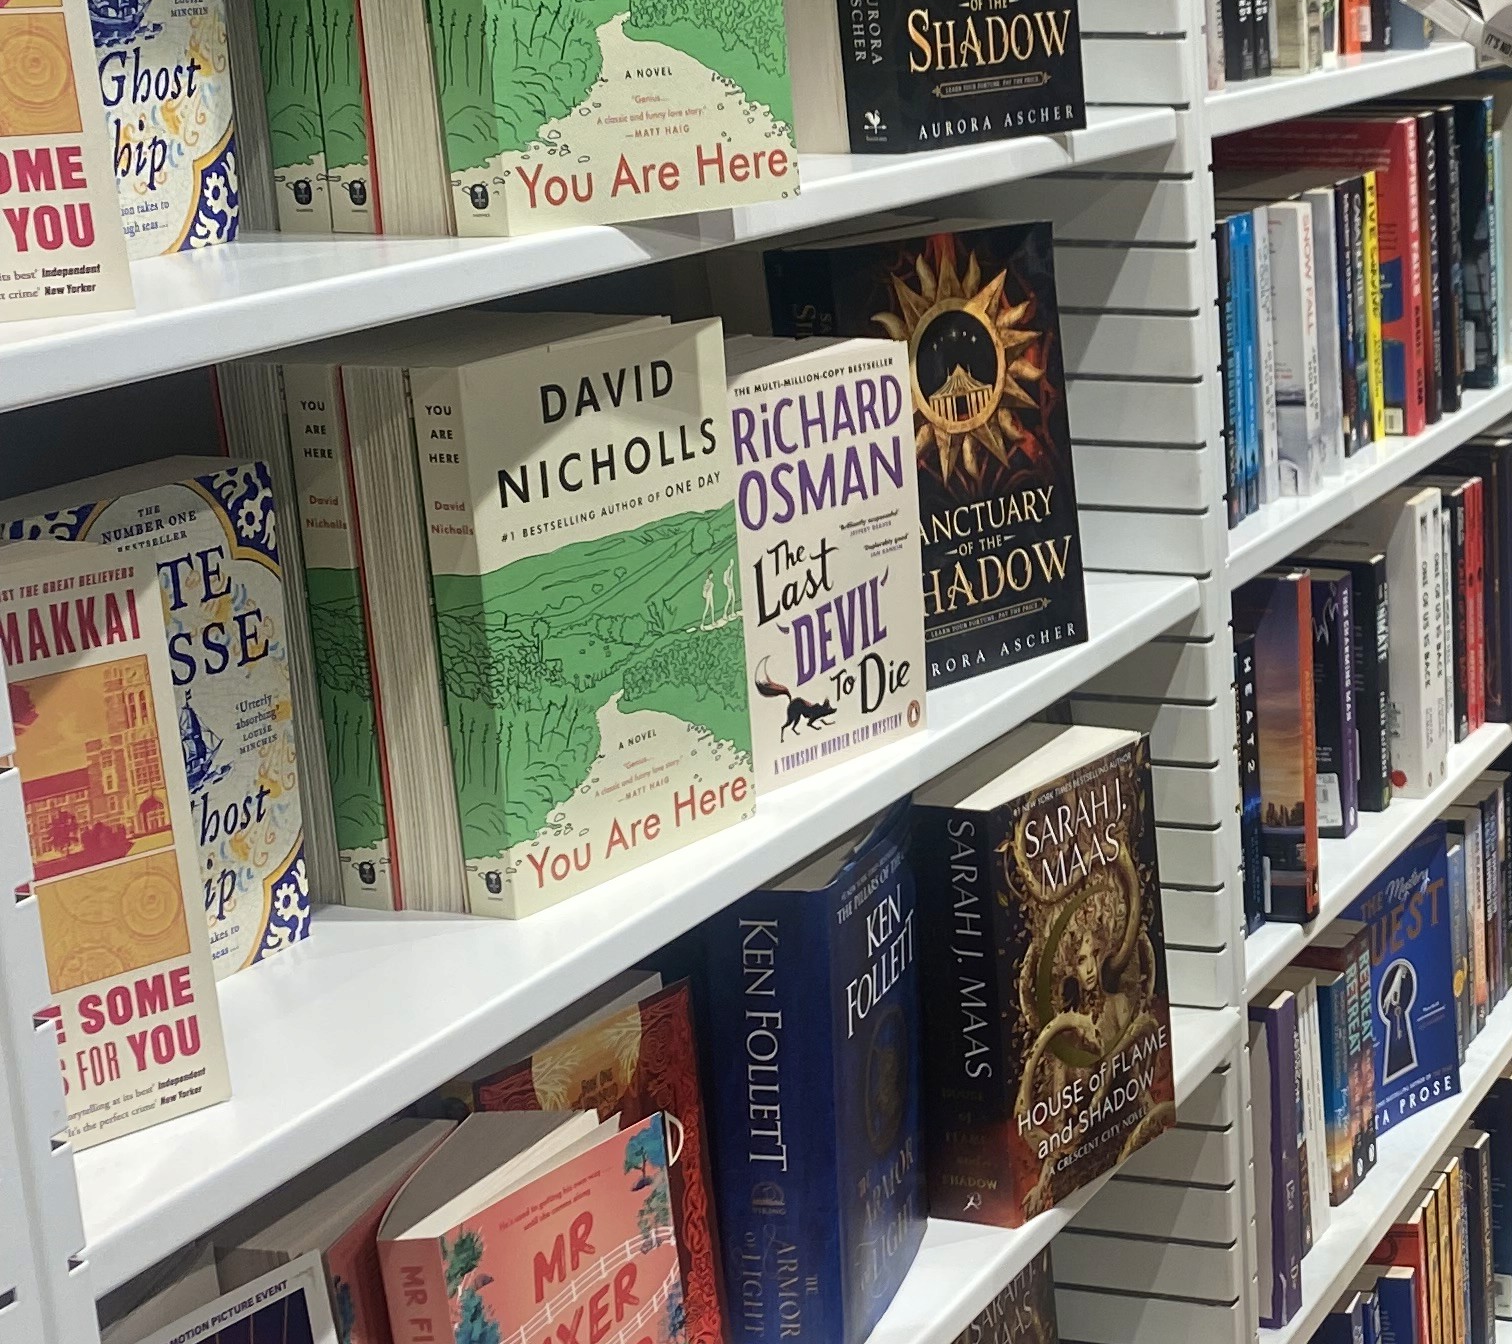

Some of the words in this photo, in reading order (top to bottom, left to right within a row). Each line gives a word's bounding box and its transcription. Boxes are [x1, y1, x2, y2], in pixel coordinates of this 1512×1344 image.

[624, 68, 633, 80] A
[635, 65, 675, 80] NOVEL
[906, 8, 1072, 75] SHADOW
[918, 115, 993, 143] AURORA
[1003, 103, 1075, 129] ASCHER
[514, 162, 594, 210] You
[610, 153, 681, 202] Are
[695, 143, 790, 191] Here
[10, 203, 96, 254] YOU
[1365, 185, 1377, 239] FIVE
[41, 262, 101, 279] Independent
[43, 285, 64, 297] New
[65, 280, 98, 296] Yorker
[539, 359, 675, 426] DAVID
[496, 416, 718, 510] NICHOLLS
[738, 435, 904, 532] OSMAN
[101, 519, 165, 545] NUMBER
[168, 510, 197, 526] ONE
[766, 538, 808, 578] The
[42, 576, 75, 594] GREAT
[78, 566, 135, 587] BELIEVERS
[755, 536, 841, 629] Last
[0, 588, 141, 666] MAKKAI
[830, 666, 856, 701] To
[858, 651, 912, 716] Die
[1023, 785, 1110, 859] SARAH
[1110, 778, 1129, 823] J.
[1039, 821, 1123, 896] MAAS
[864, 883, 903, 959] KEN
[77, 965, 196, 1037] SOME
[844, 907, 916, 1041] FOLLETT
[1358, 949, 1375, 1044] RETREAT
[1345, 962, 1362, 1058] RETREAT
[75, 1039, 121, 1091] FOR
[125, 1014, 203, 1076] YOU
[1016, 1082, 1087, 1138] HOUSE
[1088, 1062, 1110, 1096] of
[1110, 1025, 1169, 1078] FLAME
[1037, 1125, 1076, 1161] and
[1078, 1067, 1156, 1132] SHADOW
[1399, 1075, 1454, 1116] PROSE
[531, 1210, 596, 1306] MR
[210, 1300, 255, 1330] PICTURE
[254, 1279, 289, 1307] EVENT
